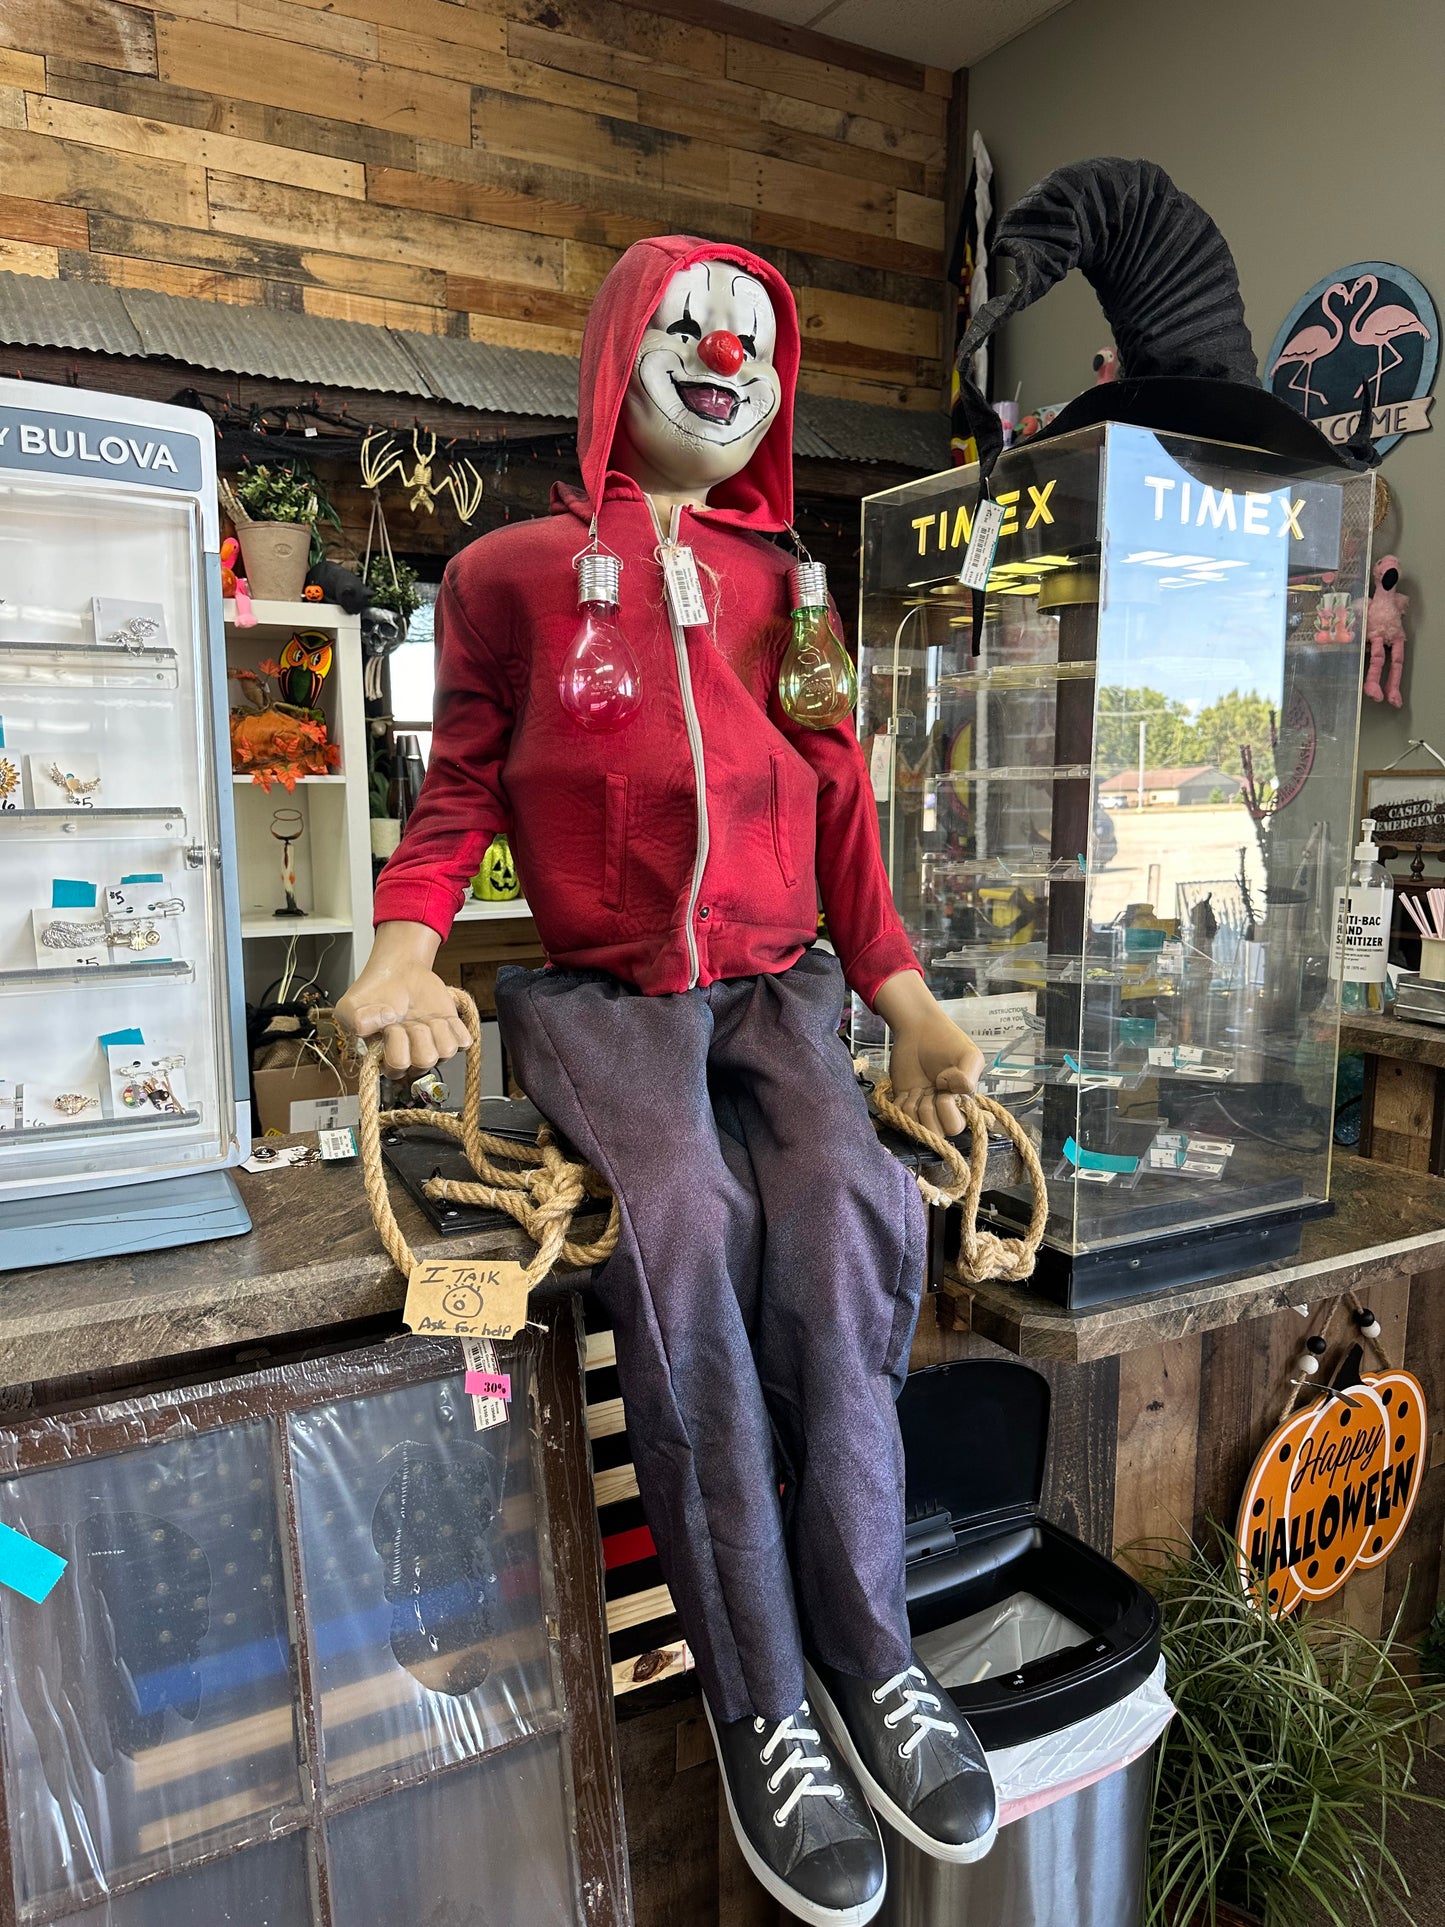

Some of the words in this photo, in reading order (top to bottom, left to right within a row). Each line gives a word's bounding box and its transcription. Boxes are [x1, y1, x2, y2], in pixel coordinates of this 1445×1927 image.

[20, 424, 179, 473] BULOVA
[1144, 475, 1306, 540] TIMEX
[1388, 804, 1420, 819] CASE
[1421, 802, 1437, 813] OF
[1336, 935, 1383, 947] SNITIZER
[420, 1266, 449, 1284] I
[418, 1316, 447, 1331] Ask
[484, 1381, 507, 1395] 30%
[1291, 1423, 1386, 1494] Happy
[1248, 1452, 1416, 1587] HALLOWEEN
